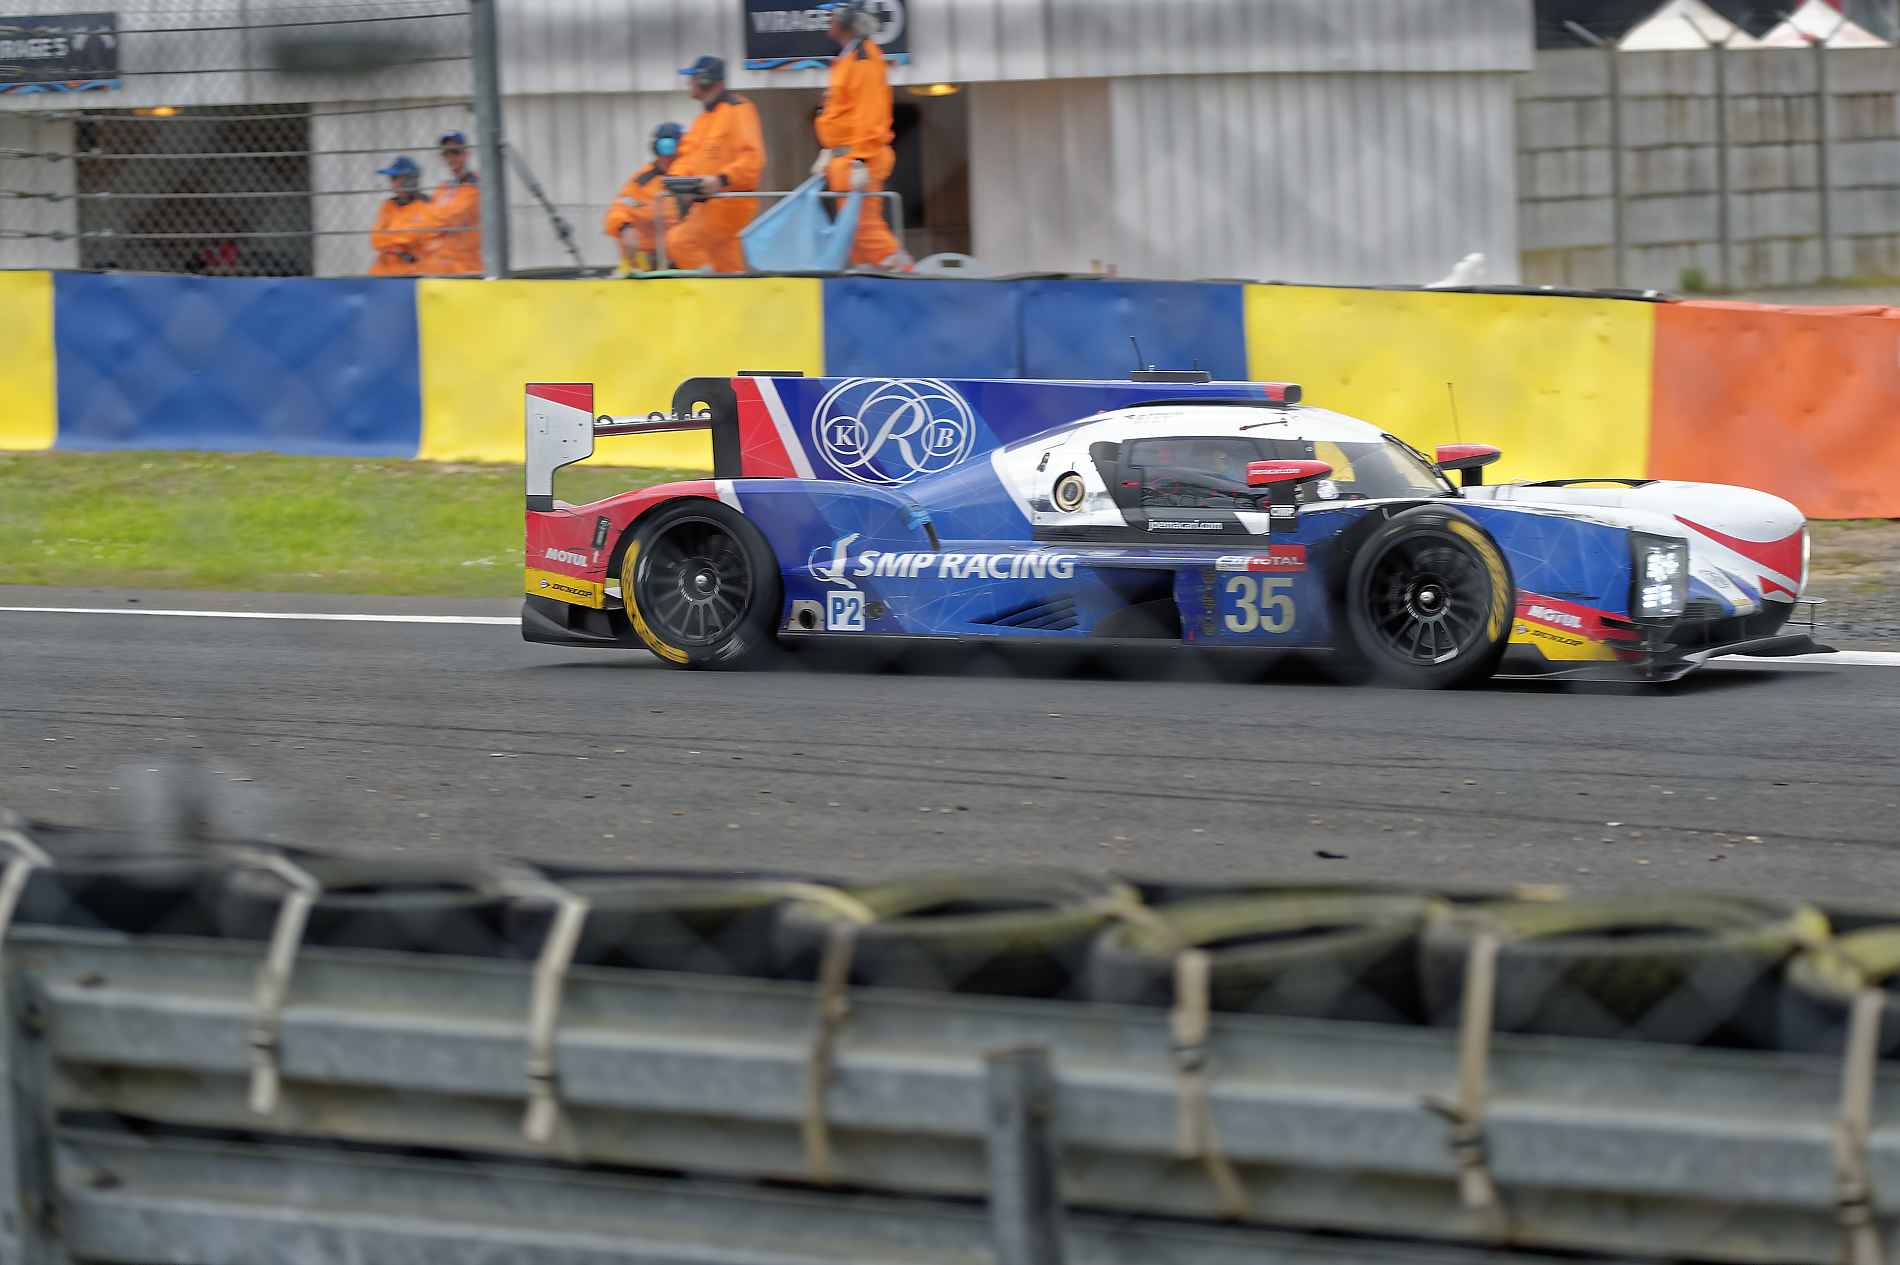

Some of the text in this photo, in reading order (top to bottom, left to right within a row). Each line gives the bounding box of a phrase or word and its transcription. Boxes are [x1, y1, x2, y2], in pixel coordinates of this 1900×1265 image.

[834, 425, 857, 446] K
[934, 427, 954, 448] B
[544, 547, 588, 567] MOTUL
[853, 551, 1077, 579] SMP RACING
[551, 583, 592, 597] DUNLOP
[832, 596, 861, 626] P2
[1224, 576, 1297, 634] 35
